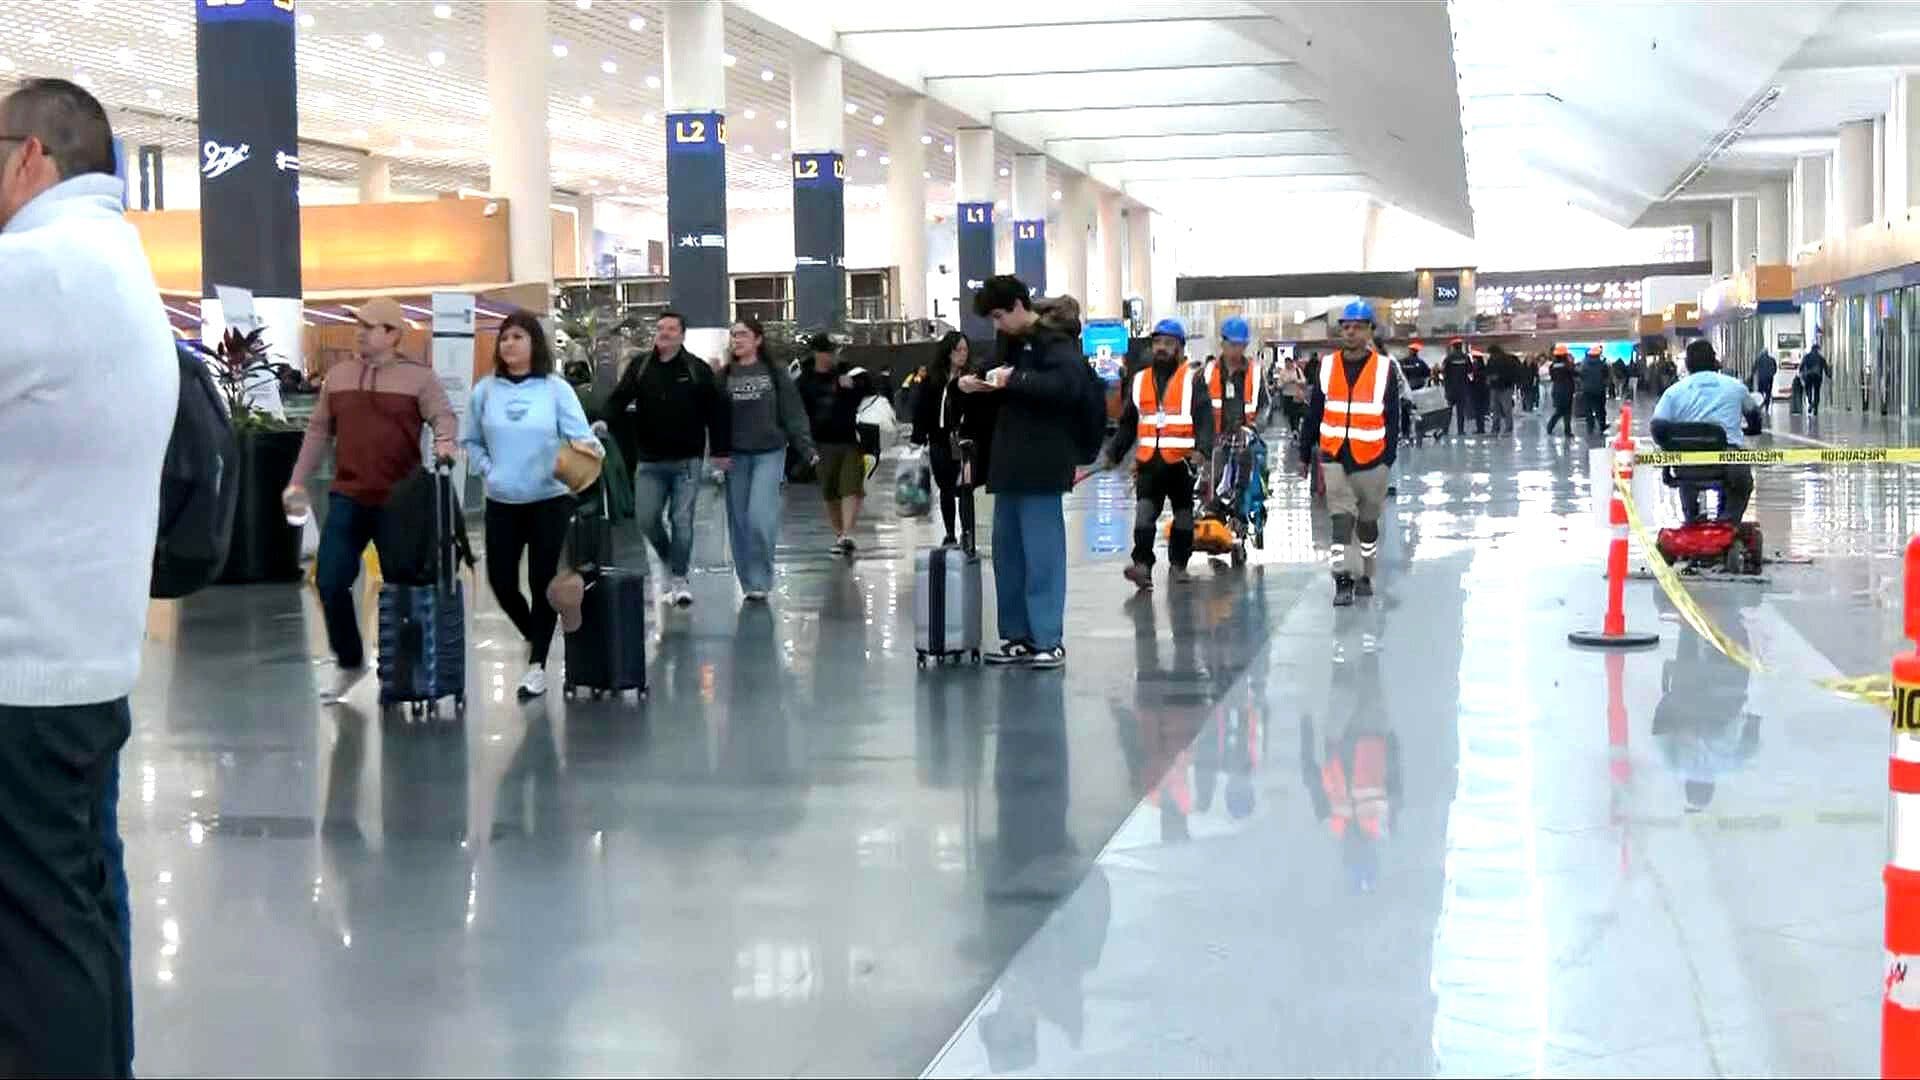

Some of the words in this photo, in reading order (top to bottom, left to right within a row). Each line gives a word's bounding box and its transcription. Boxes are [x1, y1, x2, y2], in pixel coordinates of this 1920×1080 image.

[676, 120, 705, 143] L2
[794, 160, 818, 179] L2
[967, 207, 984, 223] L1
[1019, 224, 1035, 239] L1
